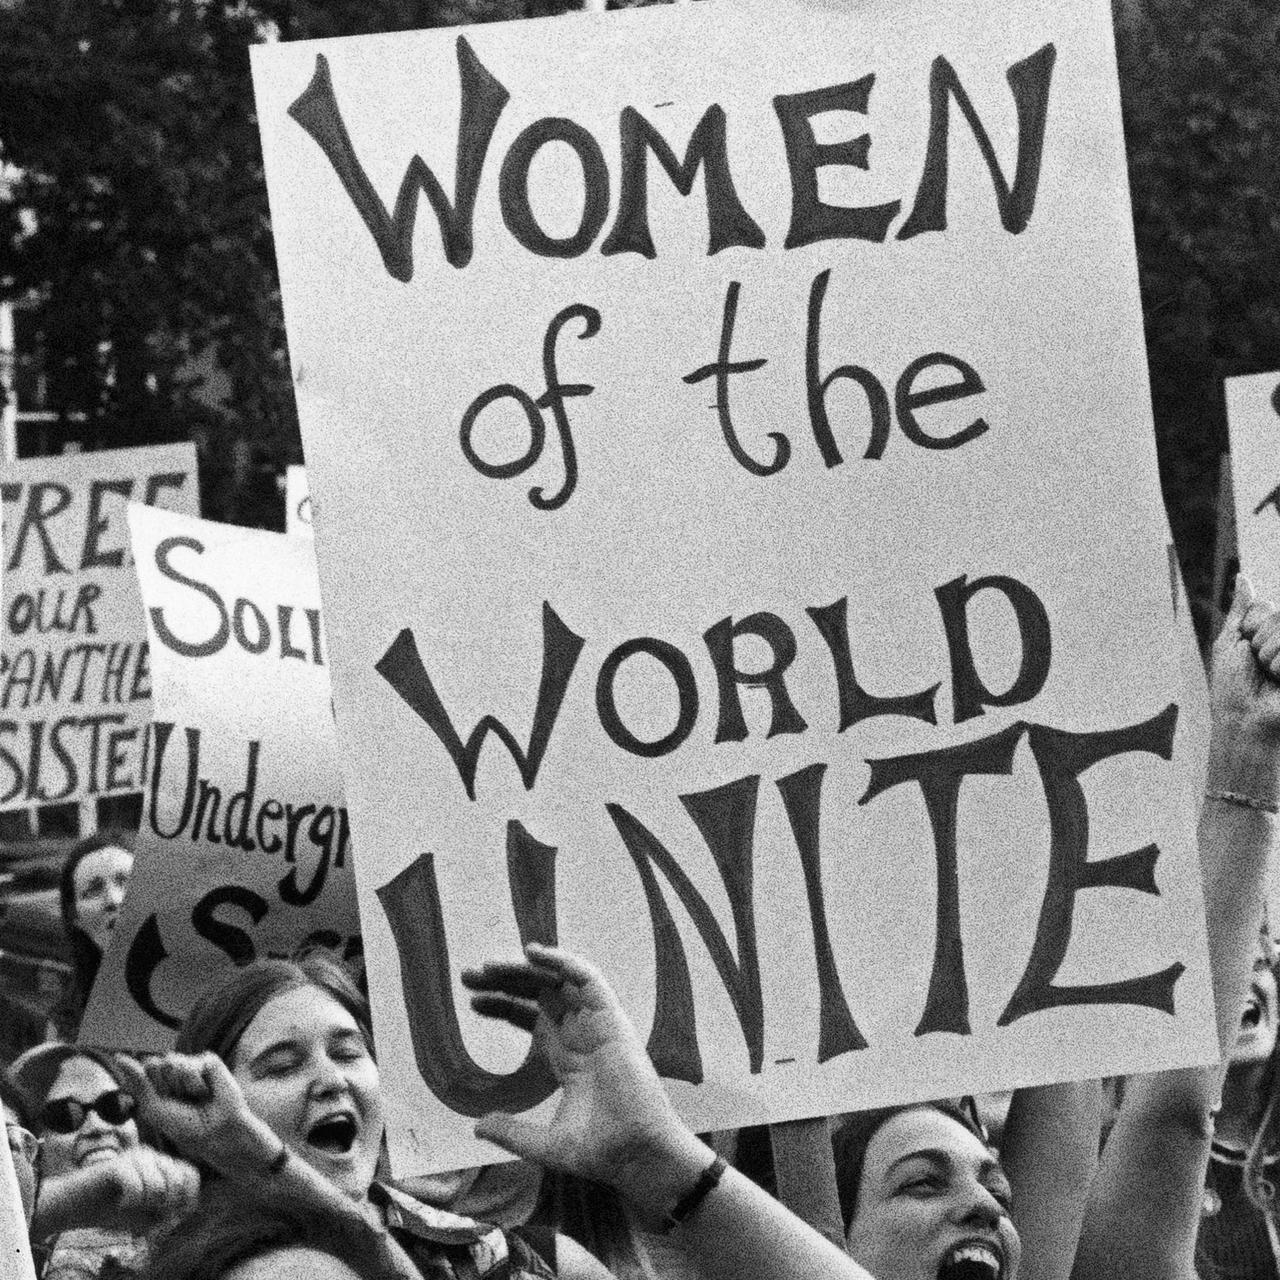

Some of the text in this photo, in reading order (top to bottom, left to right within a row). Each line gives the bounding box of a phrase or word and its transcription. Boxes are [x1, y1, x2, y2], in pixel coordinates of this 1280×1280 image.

[287, 35, 1056, 284] WOMEN
[459, 269, 989, 511] of the
[0, 641, 152, 709] ANTHE
[374, 574, 1052, 800] WORLD
[375, 702, 1186, 1118] UNITE
